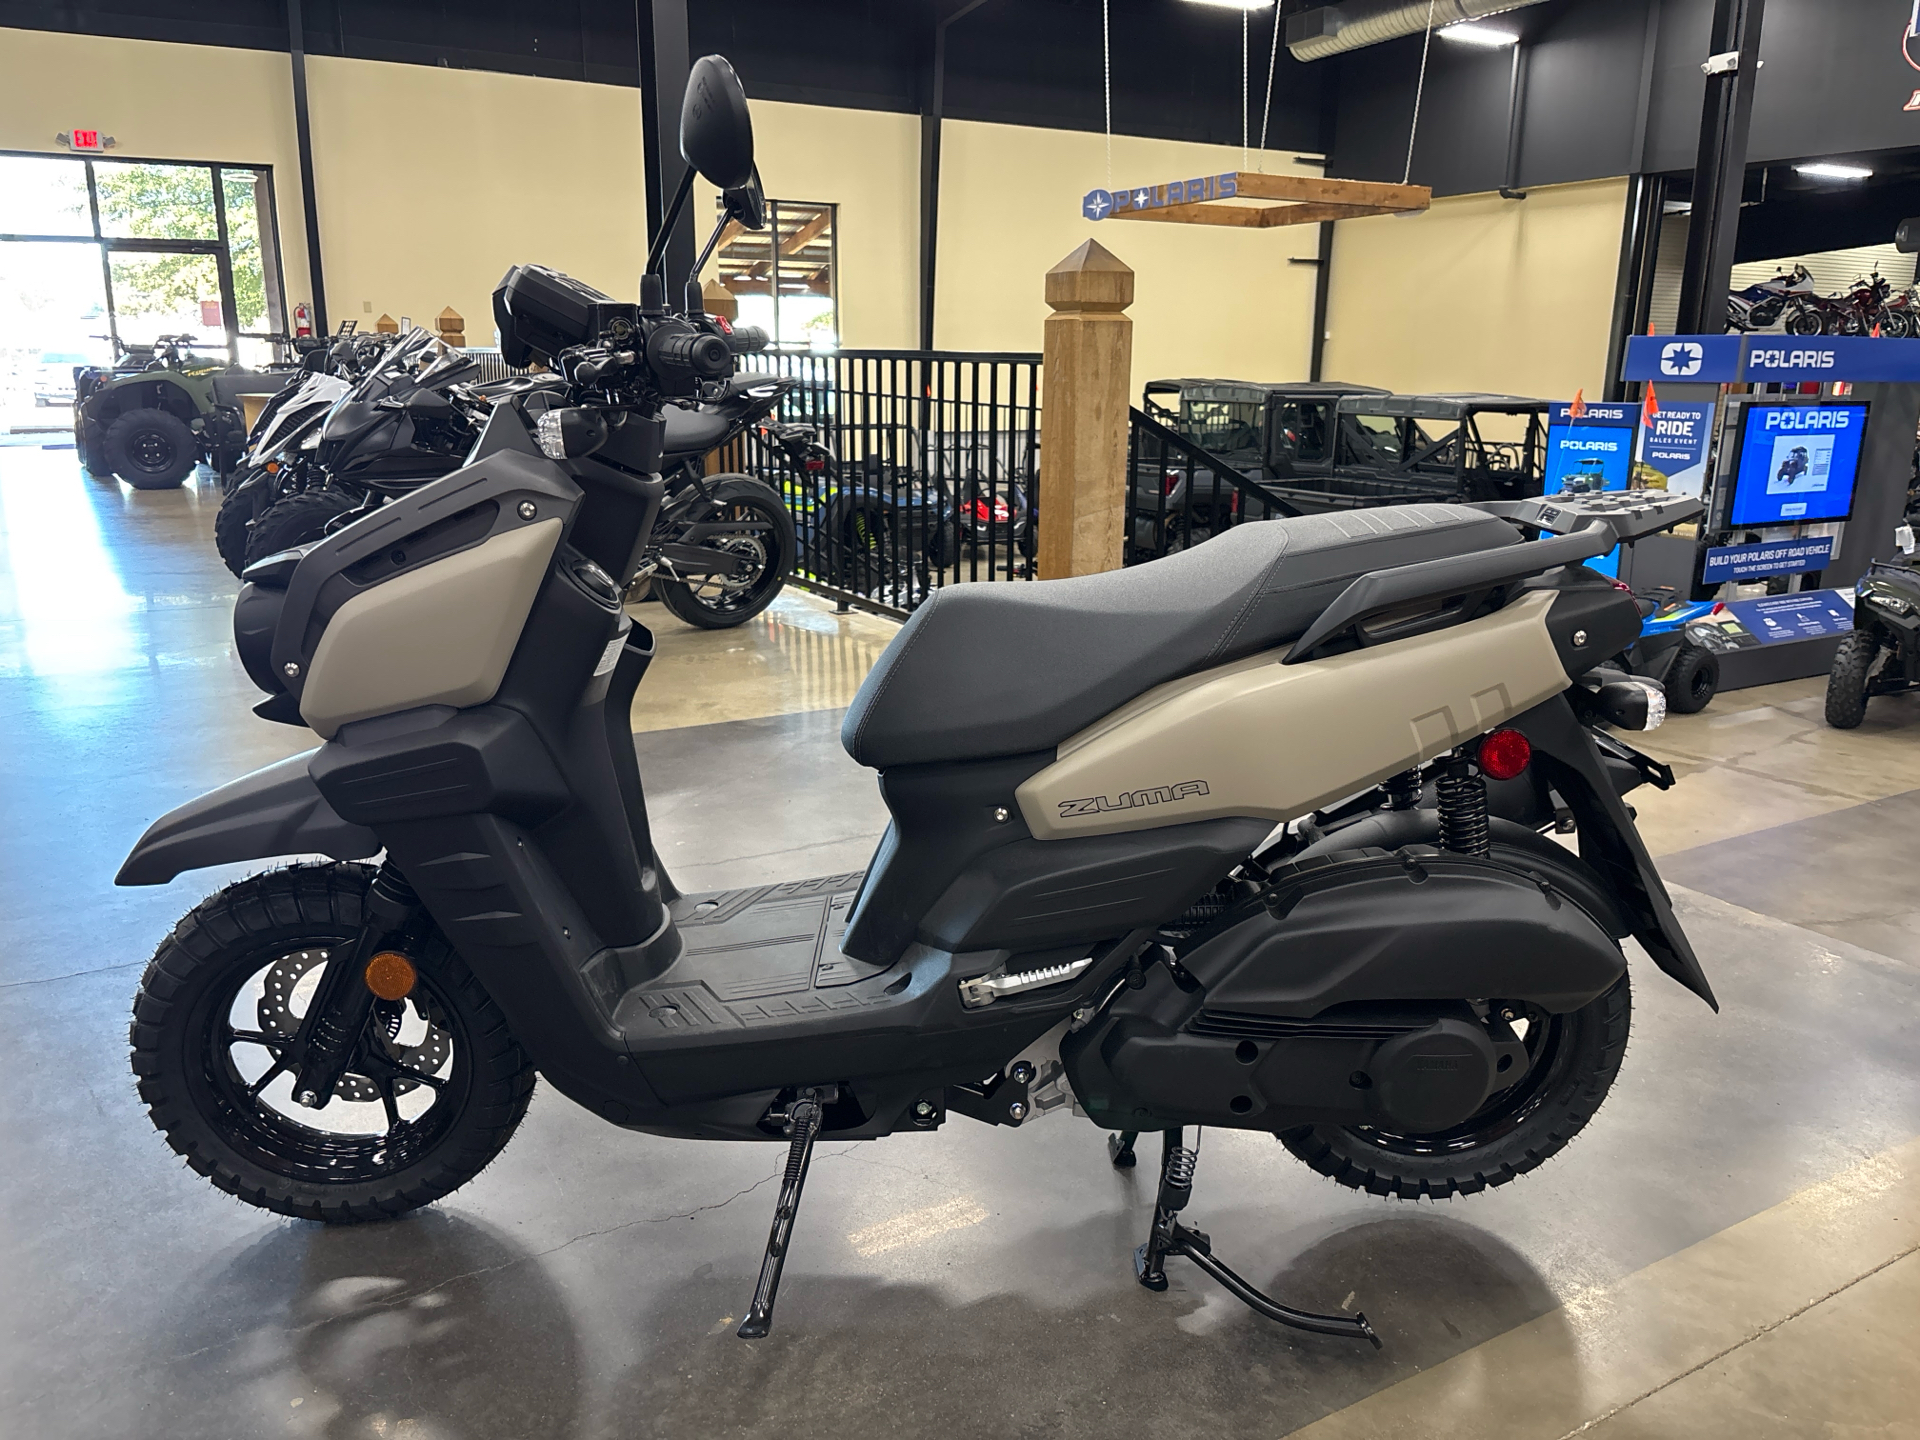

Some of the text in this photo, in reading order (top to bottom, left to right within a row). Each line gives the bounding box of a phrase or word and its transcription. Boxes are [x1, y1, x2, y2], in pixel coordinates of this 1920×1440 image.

[1114, 171, 1237, 213] POLARIS
[1749, 349, 1835, 368] POLARIS
[1560, 407, 1624, 419] PLARIS
[1667, 411, 1691, 420] READY
[1692, 412, 1701, 420] TO
[1765, 411, 1850, 430] POLARIS
[1655, 420, 1695, 437] RIDE
[1560, 439, 1618, 452] POLARIS
[1651, 451, 1691, 460] POLARIS
[1709, 544, 1830, 567] BUILD YOUR POLARIS OFF ROAD VEHICLE
[1058, 779, 1210, 818] ZUMA
